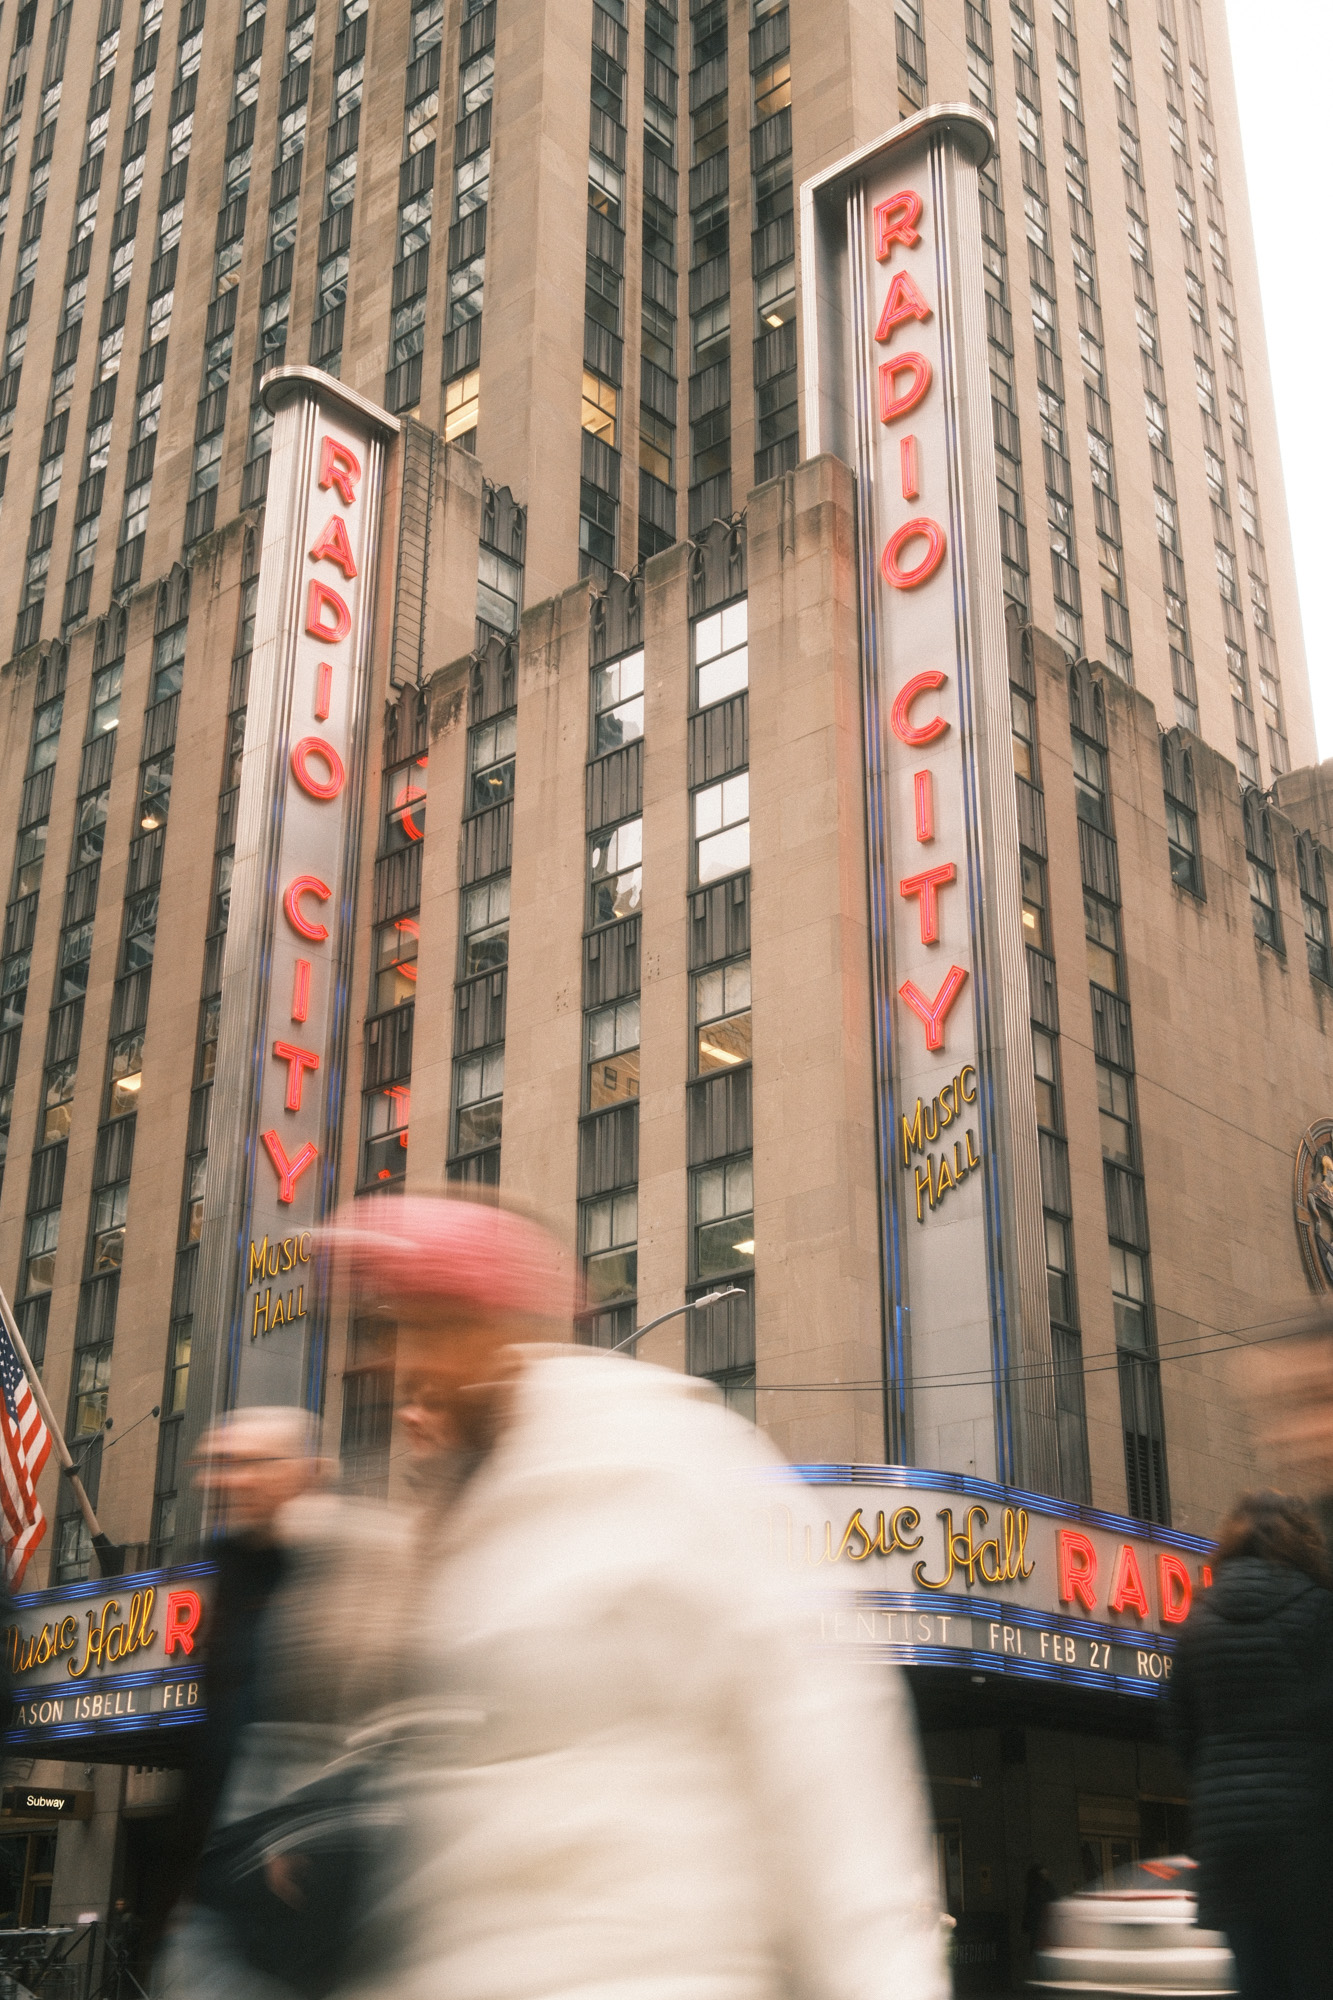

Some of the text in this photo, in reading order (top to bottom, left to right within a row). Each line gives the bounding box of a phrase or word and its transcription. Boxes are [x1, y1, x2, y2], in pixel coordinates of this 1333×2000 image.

[873, 189, 969, 1052] RADIO CITY
[260, 434, 362, 1204] RADIO CITY
[902, 1064, 977, 1169] MUSIC
[915, 1128, 981, 1224] HALL
[248, 1231, 311, 1287] MUSIC
[251, 1285, 308, 1341] HALL
[912, 1504, 1036, 1590] Hall
[67, 1585, 158, 1678] Hall
[989, 1622, 1027, 1656] FRI.
[1040, 1631, 1076, 1664] FEB
[1089, 1641, 1111, 1670] 27
[75, 1690, 136, 1720] ISBELL
[163, 1682, 200, 1709] FEB
[26, 1795, 65, 1811] Subway
